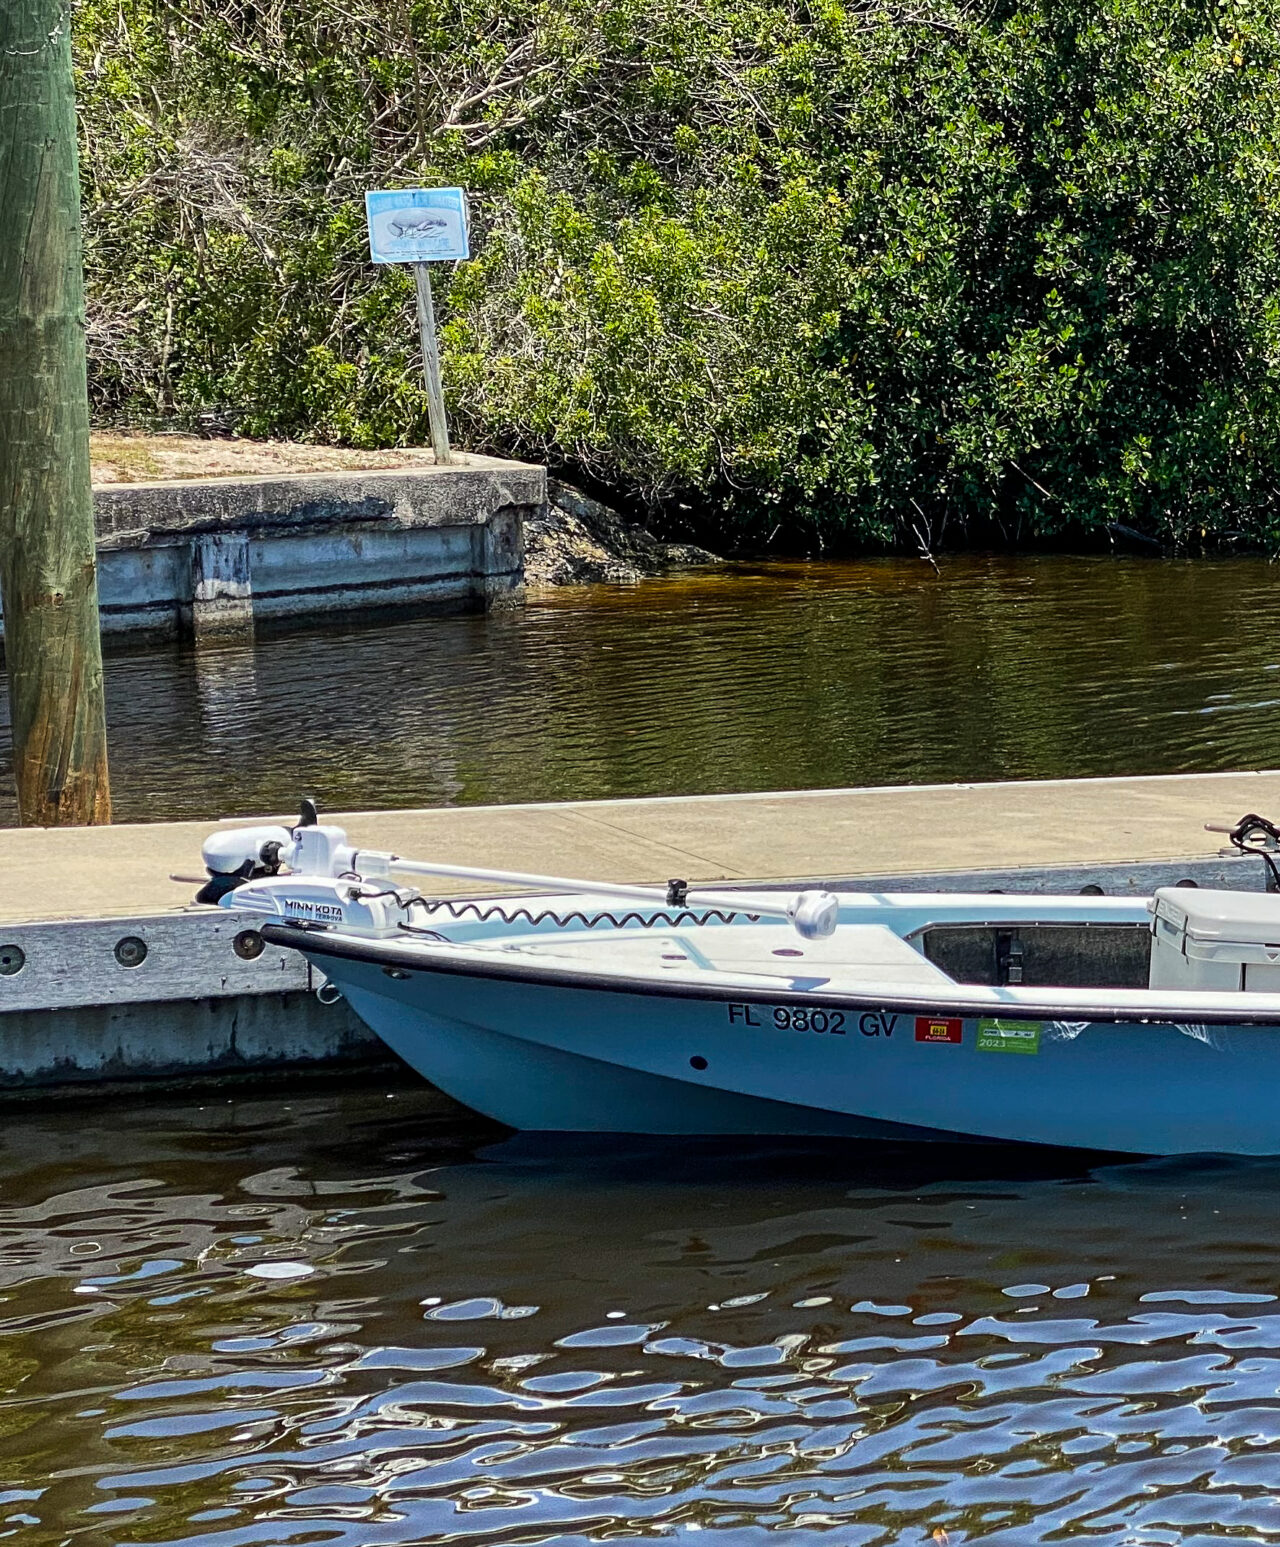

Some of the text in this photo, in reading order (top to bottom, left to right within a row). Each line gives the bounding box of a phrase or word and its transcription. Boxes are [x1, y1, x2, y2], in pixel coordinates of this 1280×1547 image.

[284, 900, 343, 916] MINN KOTA
[728, 1004, 898, 1038] FL 9802 GV
